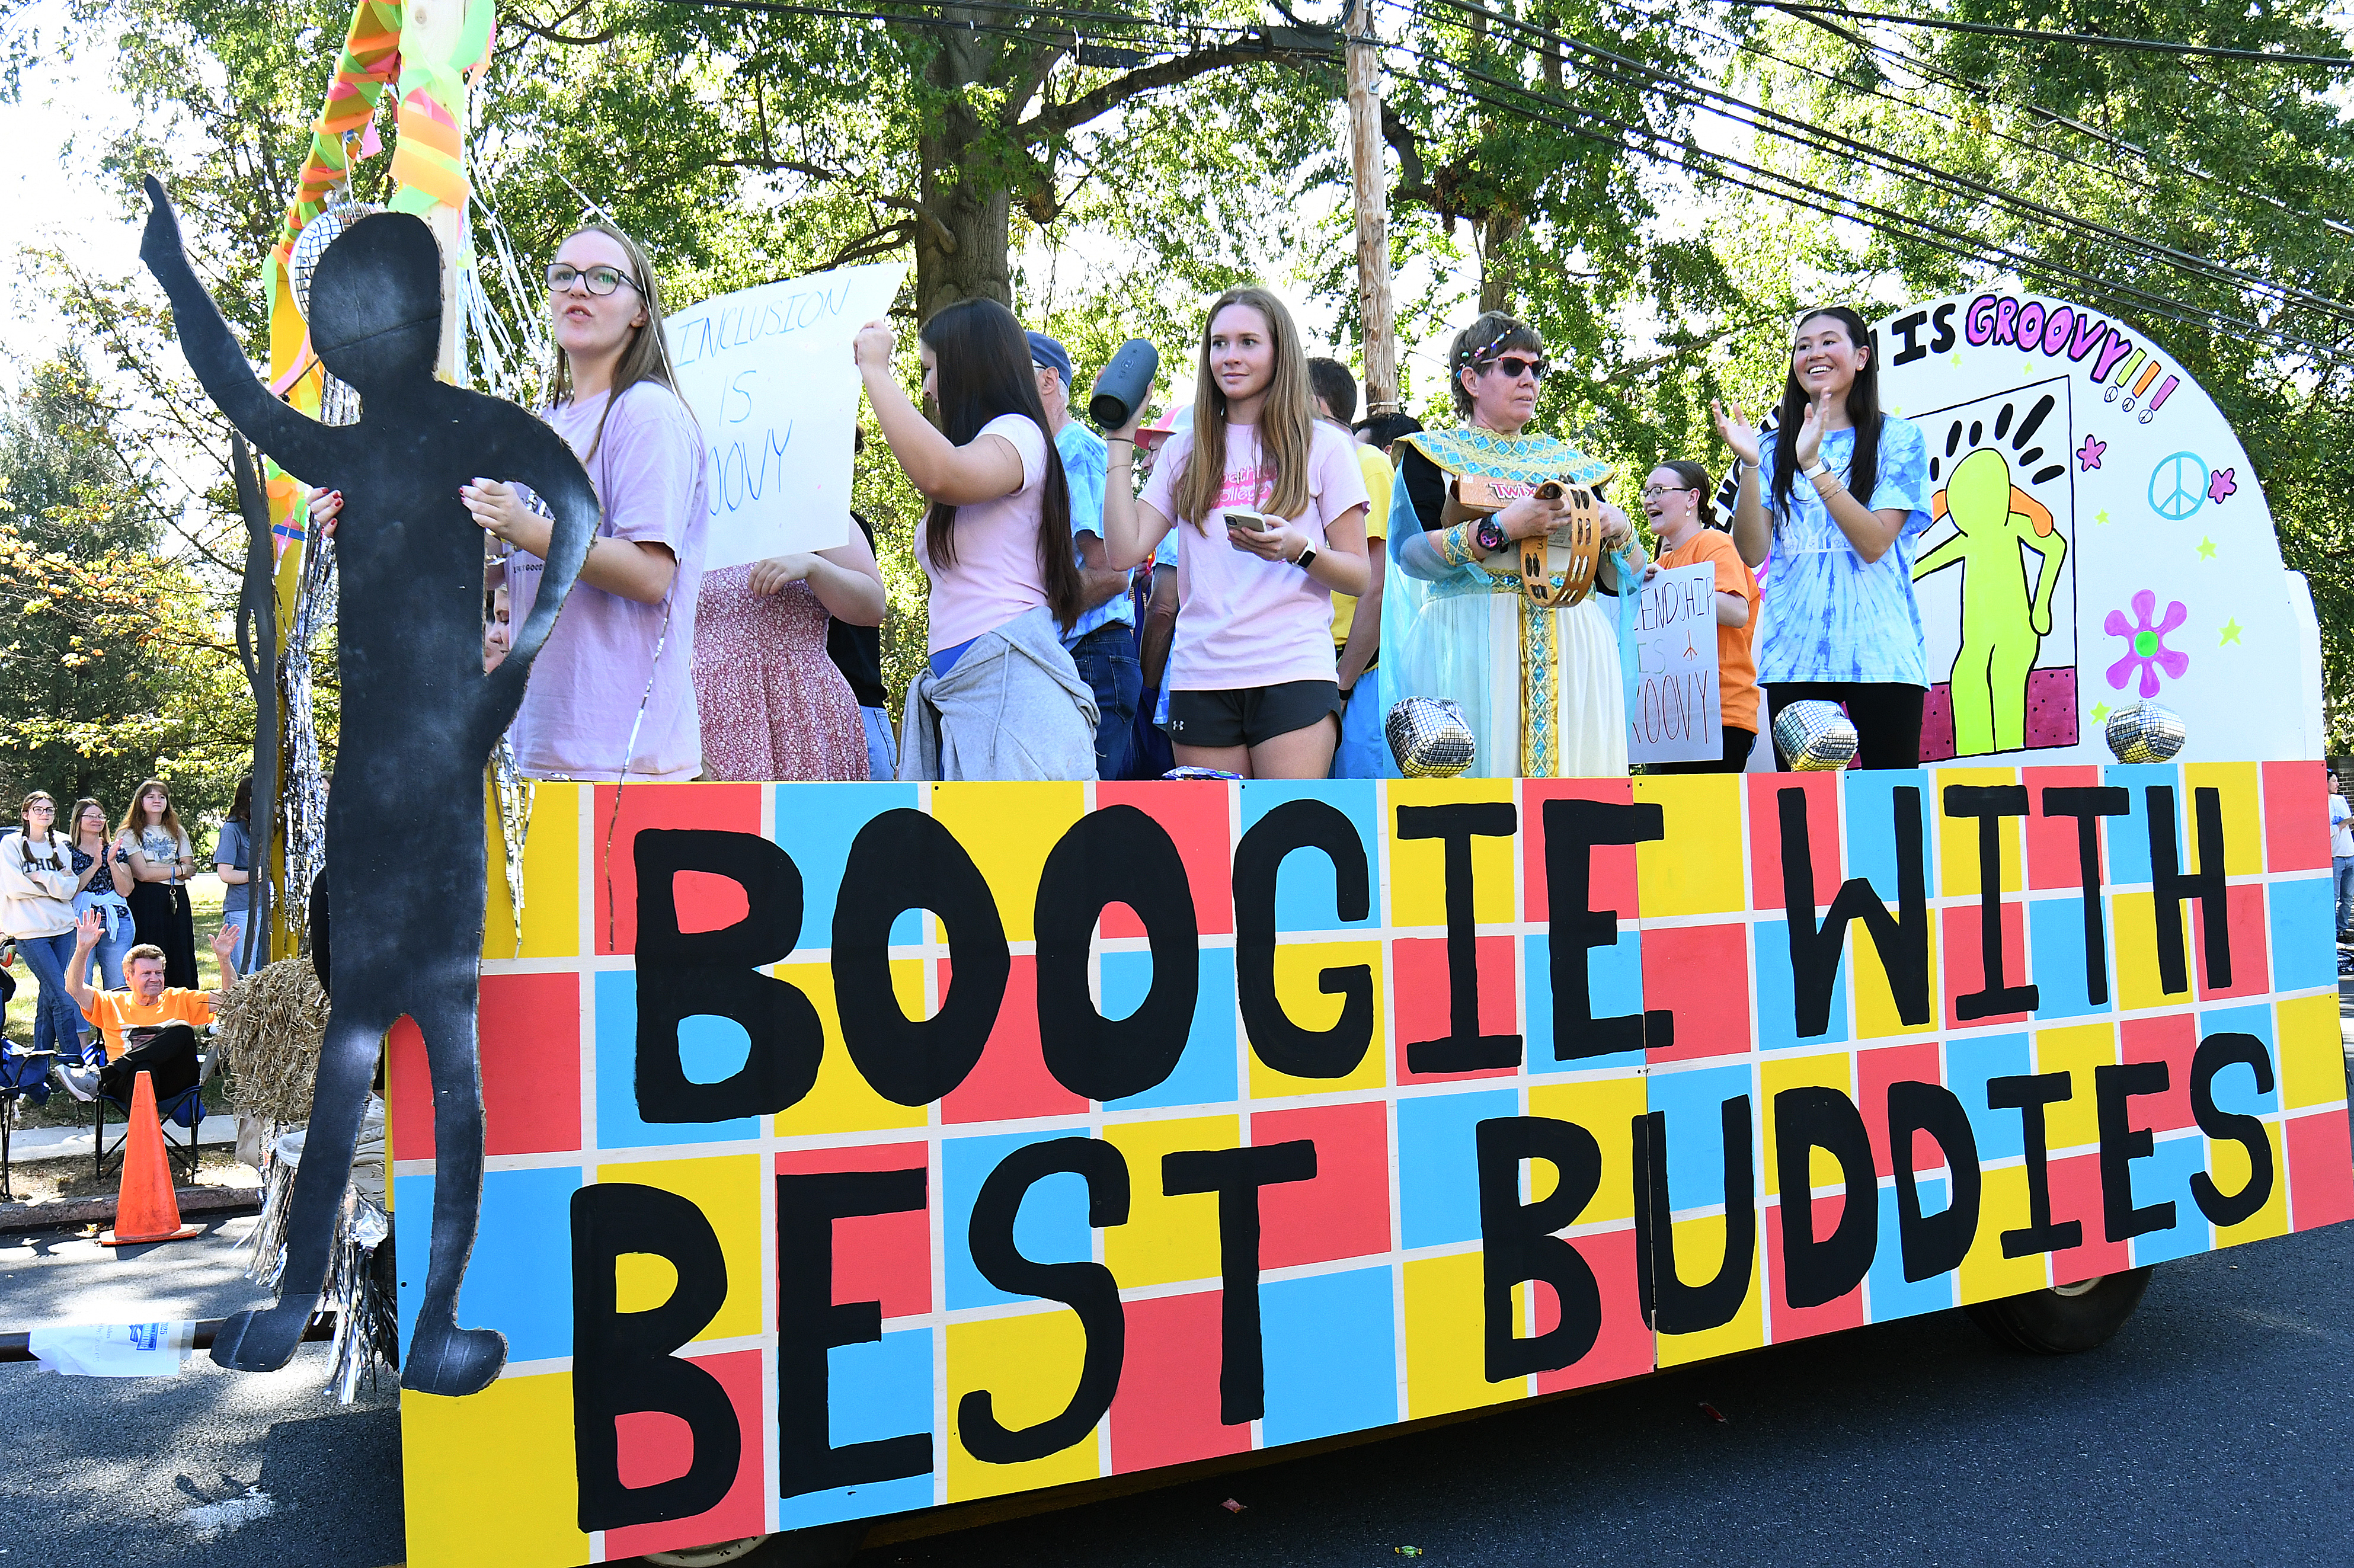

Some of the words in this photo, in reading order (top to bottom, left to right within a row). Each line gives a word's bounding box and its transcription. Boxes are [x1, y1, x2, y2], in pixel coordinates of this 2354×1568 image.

[674, 279, 851, 367] INCLUSION
[1892, 303, 1956, 366] IS
[719, 370, 756, 427] IS
[708, 419, 792, 516] OOVY
[634, 799, 1674, 1124] BOOGIE
[1777, 785, 2233, 1038] WITH
[570, 1137, 1317, 1534] BEST
[1476, 1032, 2275, 1383] BUDDIES
